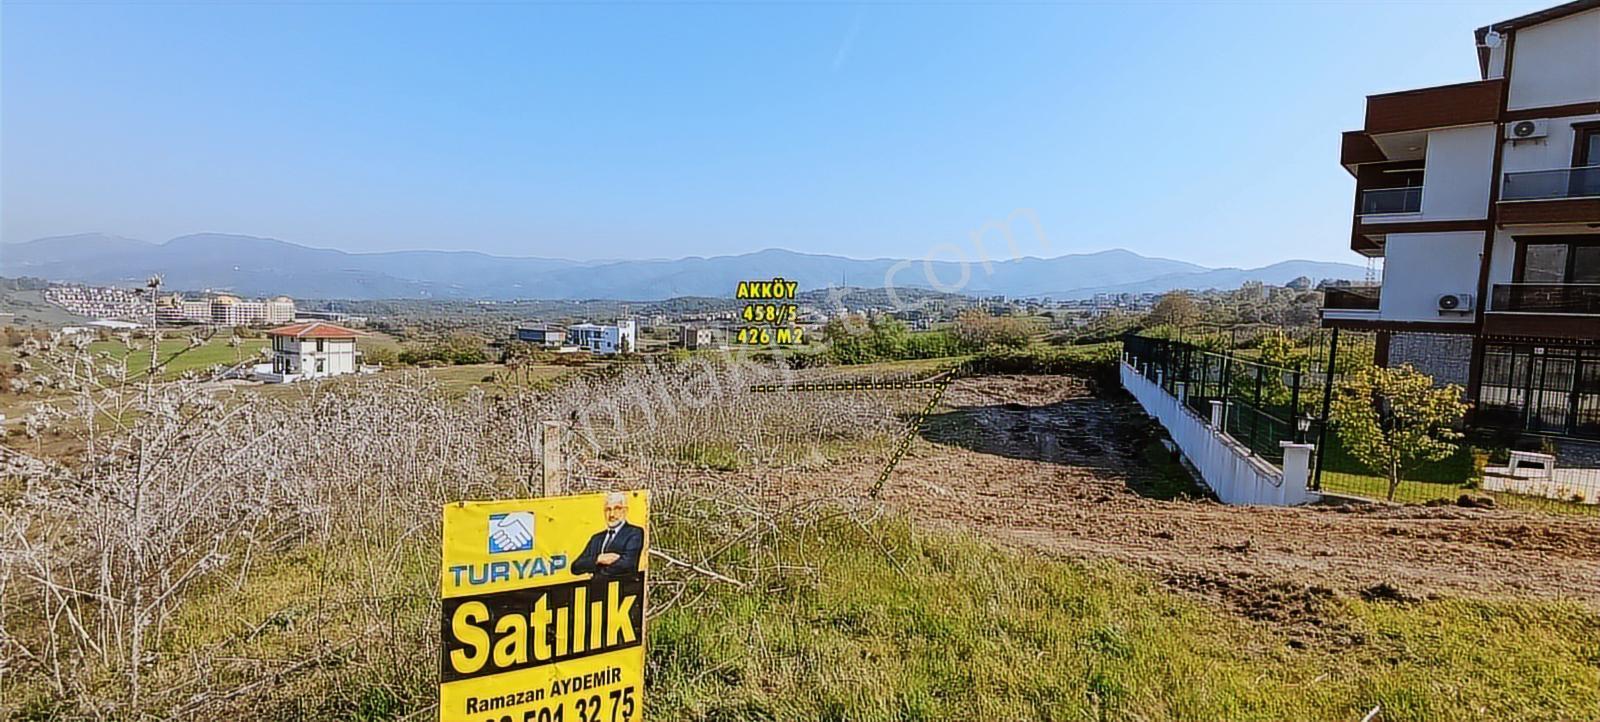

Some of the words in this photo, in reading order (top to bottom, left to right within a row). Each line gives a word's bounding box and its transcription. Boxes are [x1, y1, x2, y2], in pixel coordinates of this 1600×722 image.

[448, 554, 568, 587] TURYAP
[450, 581, 637, 675] Satılık
[466, 688, 545, 714] Ramazan
[550, 666, 622, 698] AYDEMİR
[575, 695, 601, 722] 32
[609, 686, 635, 722] 75
